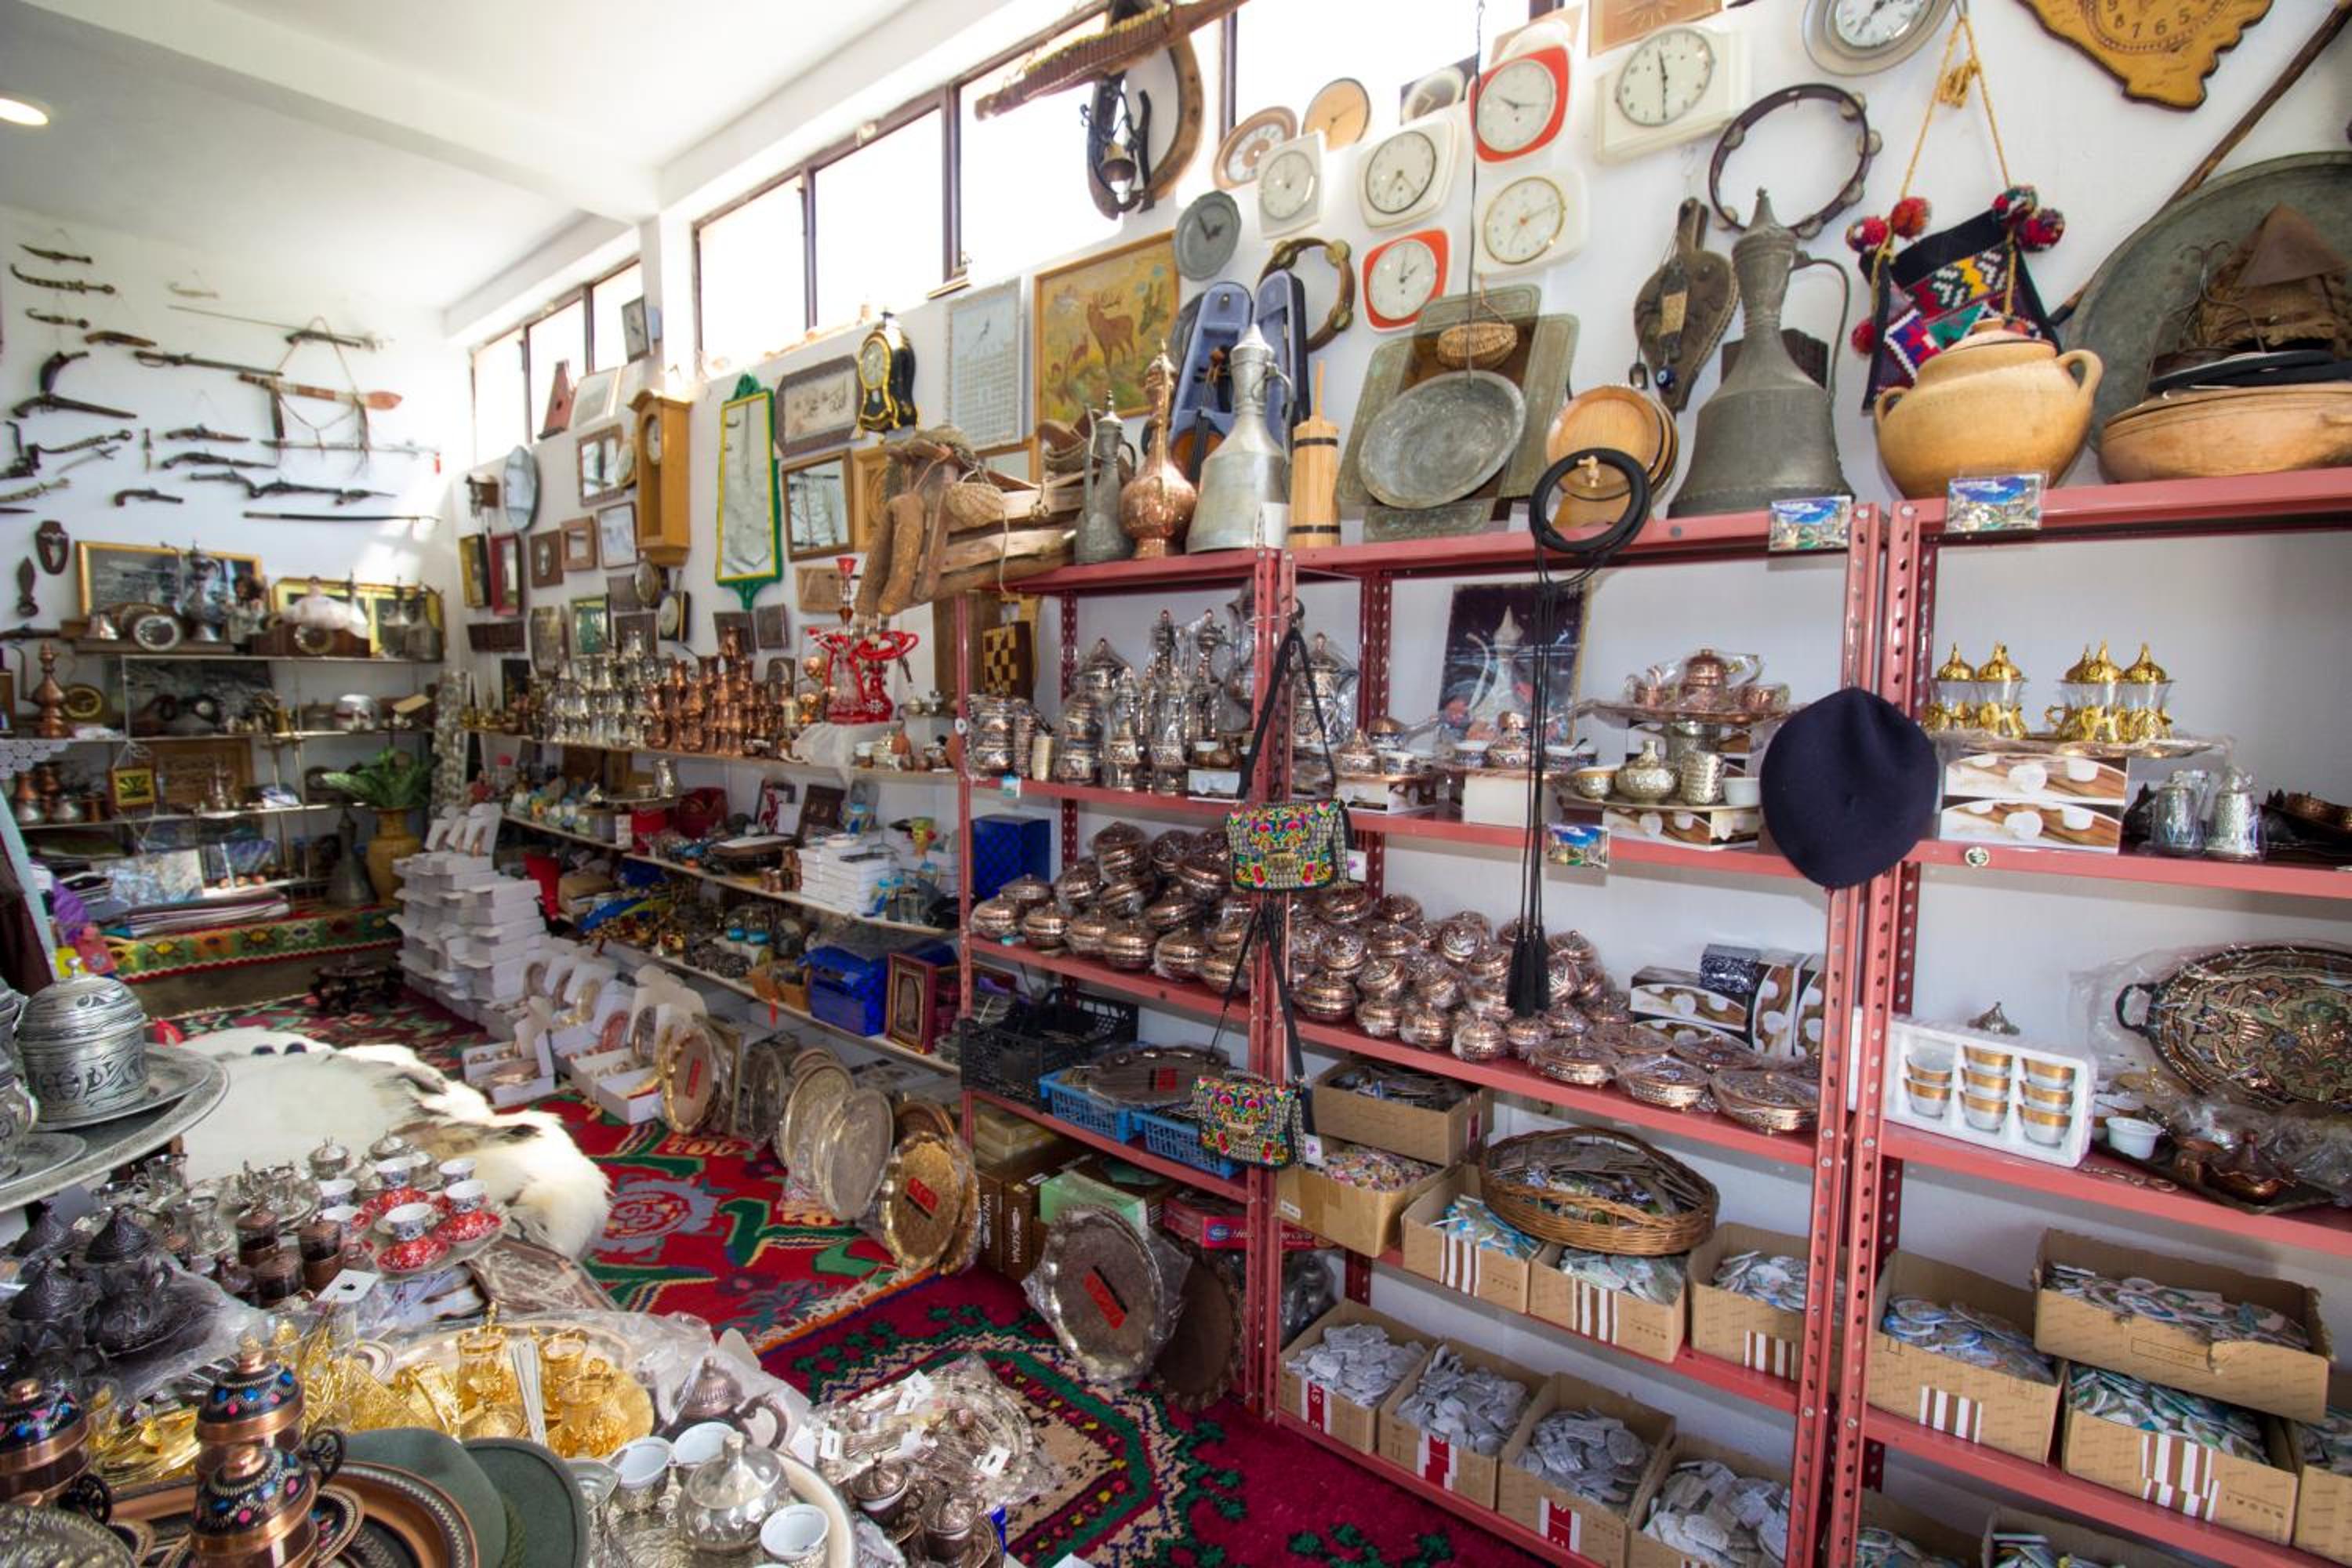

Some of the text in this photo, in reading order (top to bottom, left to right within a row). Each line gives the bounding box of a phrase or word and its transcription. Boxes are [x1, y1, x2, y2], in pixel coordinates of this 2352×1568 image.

[2114, 13, 2125, 29] 8
[2178, 7, 2191, 25] 5
[2132, 22, 2141, 38] 7
[2155, 18, 2167, 35] 6
